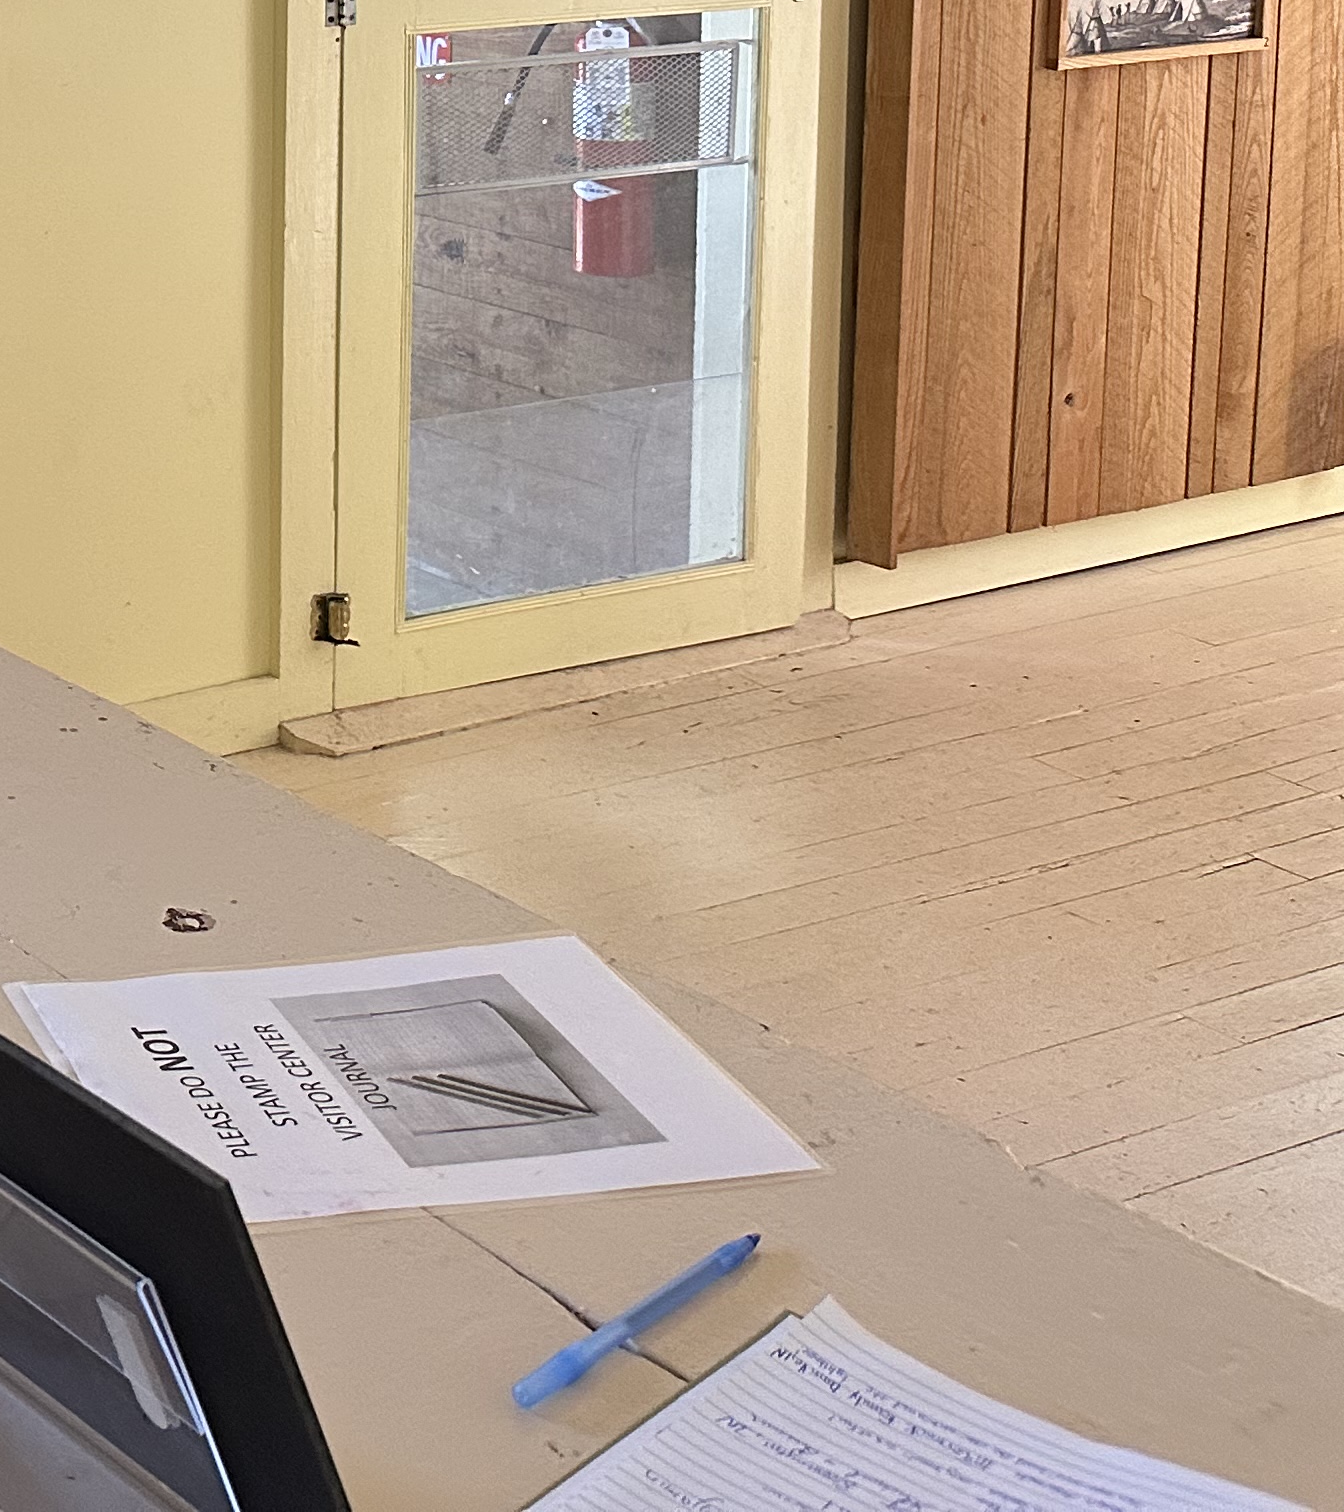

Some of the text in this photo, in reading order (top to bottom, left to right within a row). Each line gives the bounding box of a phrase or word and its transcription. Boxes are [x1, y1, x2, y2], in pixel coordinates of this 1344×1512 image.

[131, 1027, 258, 1158] PLEASE DO NOT
[215, 1042, 298, 1127] STAMP THE
[253, 1023, 363, 1141] VISITOR CENTER
[323, 1043, 398, 1111] JOURNAL
